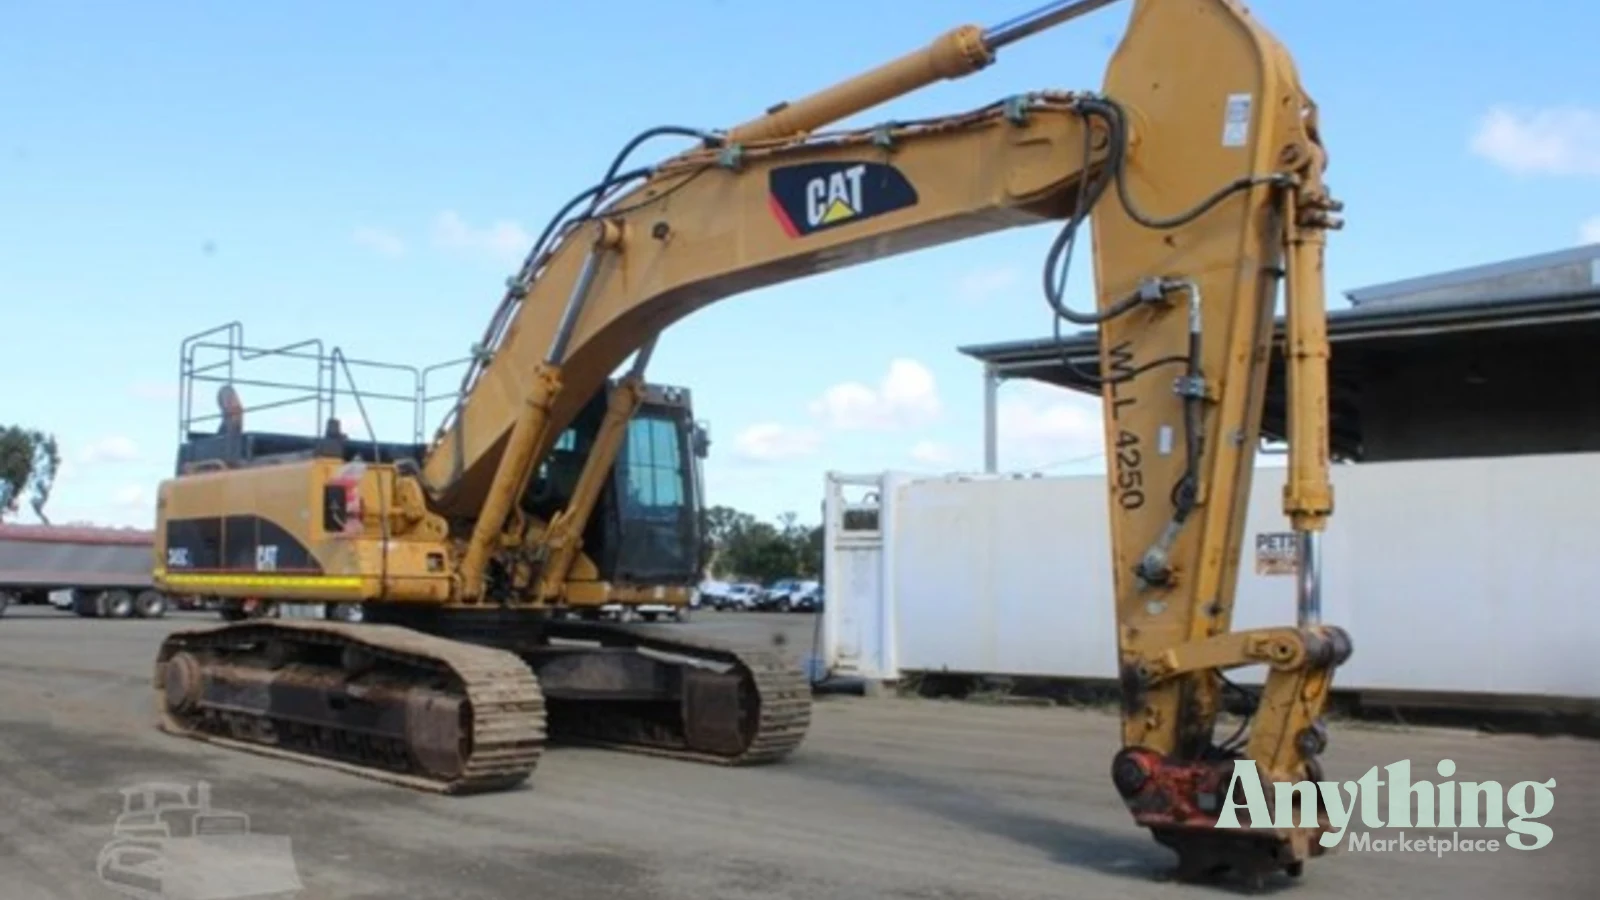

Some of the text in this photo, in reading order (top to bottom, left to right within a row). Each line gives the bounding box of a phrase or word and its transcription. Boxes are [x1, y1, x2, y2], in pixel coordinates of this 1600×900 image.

[806, 164, 866, 226] CAT
[1109, 340, 1145, 510] WLL 4250
[256, 544, 278, 571] CAT
